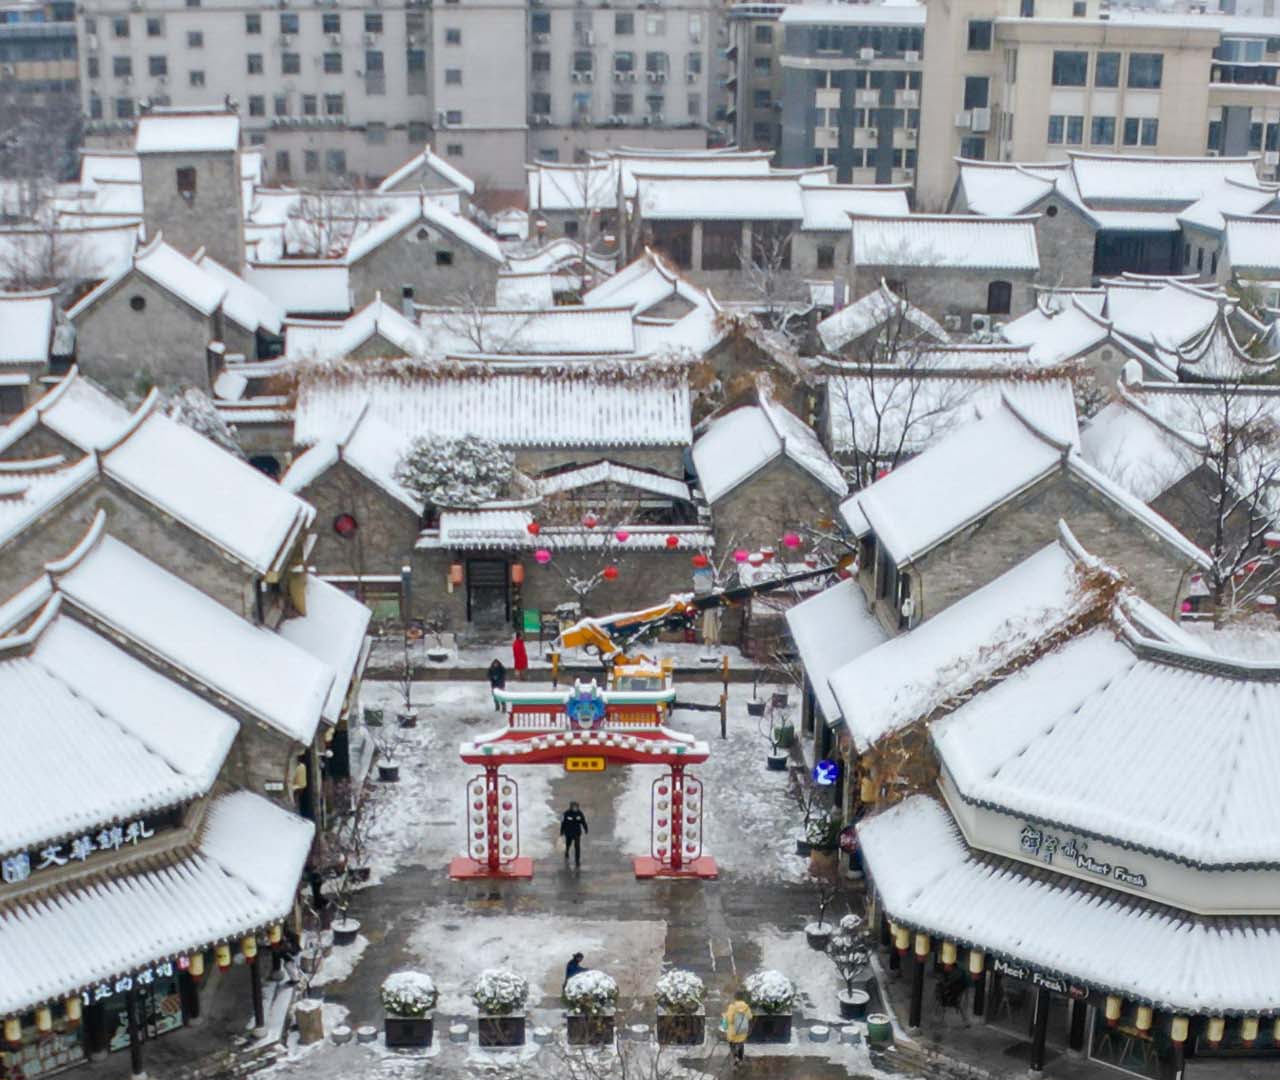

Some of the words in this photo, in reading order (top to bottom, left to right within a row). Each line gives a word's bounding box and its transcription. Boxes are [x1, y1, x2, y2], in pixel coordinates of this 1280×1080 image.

[1114, 866, 1147, 888] Fresh
[994, 959, 1025, 979] Meet
[1033, 972, 1062, 993] Fresh
